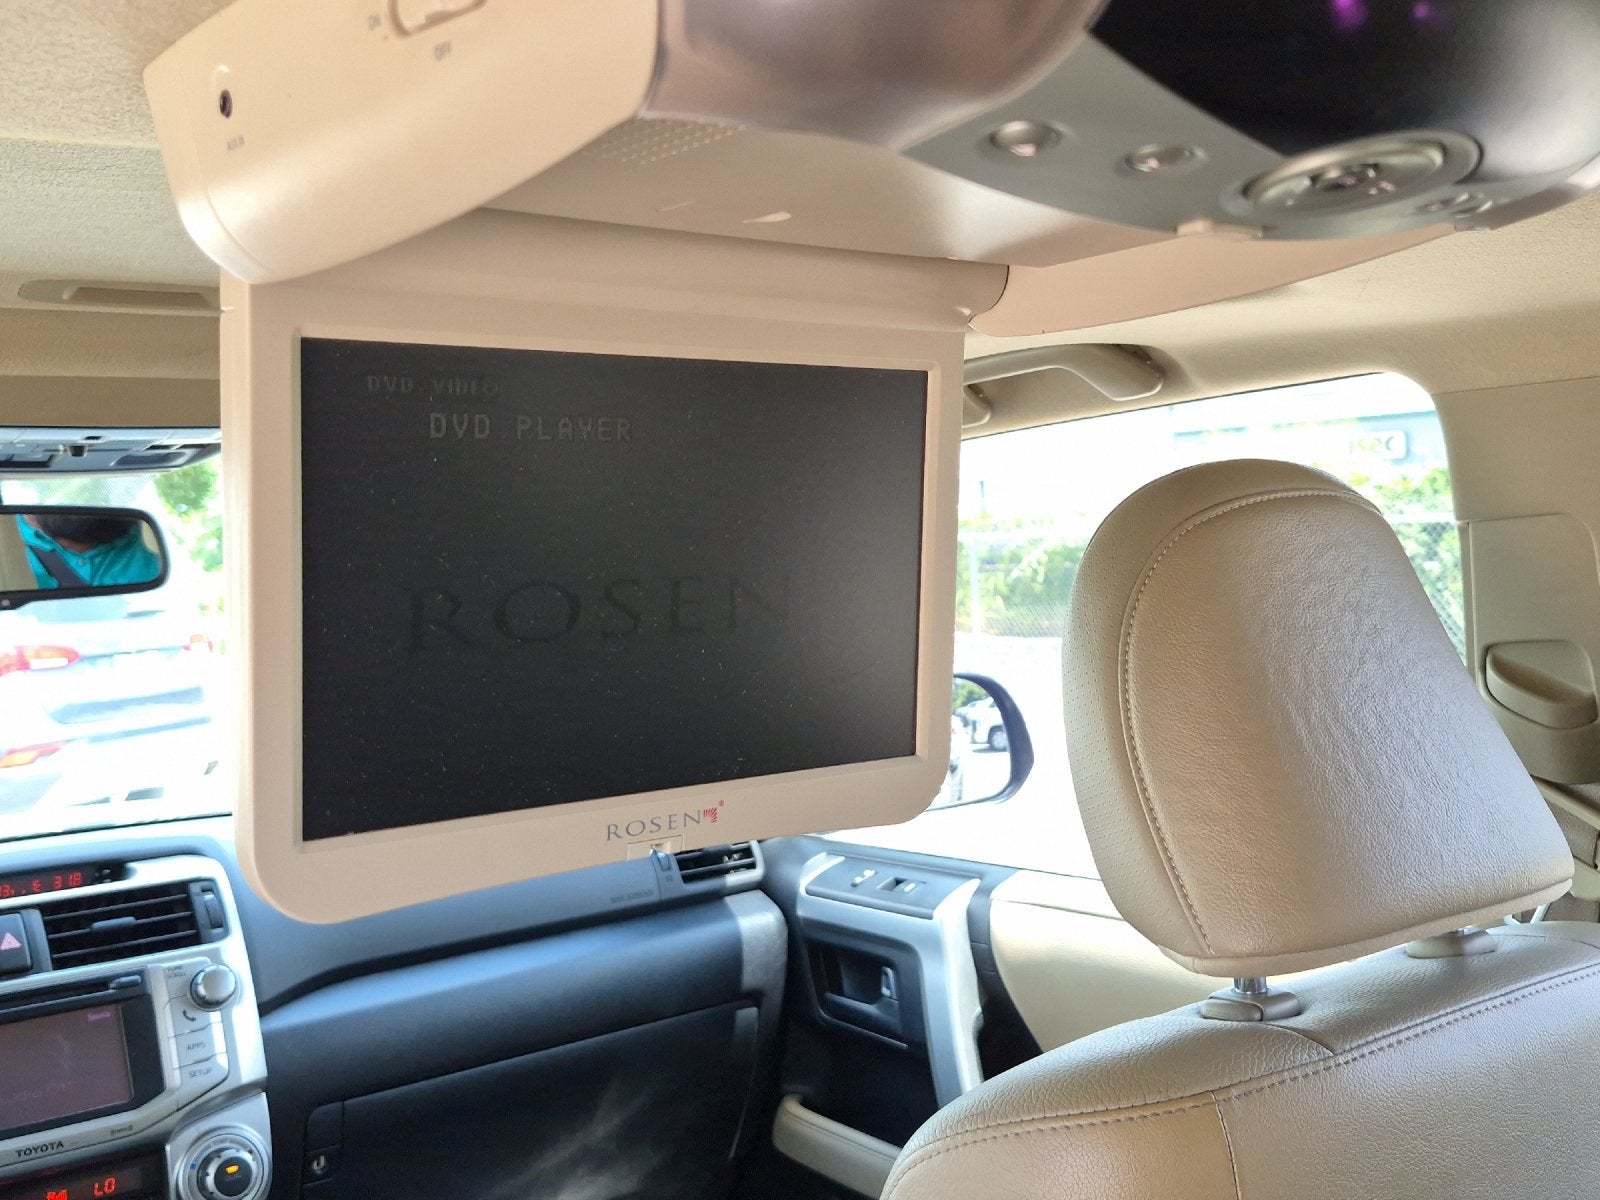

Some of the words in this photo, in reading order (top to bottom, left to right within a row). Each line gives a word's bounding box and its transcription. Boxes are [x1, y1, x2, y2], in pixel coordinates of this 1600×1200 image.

[429, 411, 492, 440] DVD
[515, 415, 633, 442] PLAYER
[406, 575, 792, 654] ROSEN
[605, 808, 702, 842] ROSEN
[188, 1067, 212, 1078] SETUP
[16, 1140, 65, 1158] TOYOTA
[93, 1177, 117, 1197] LO
